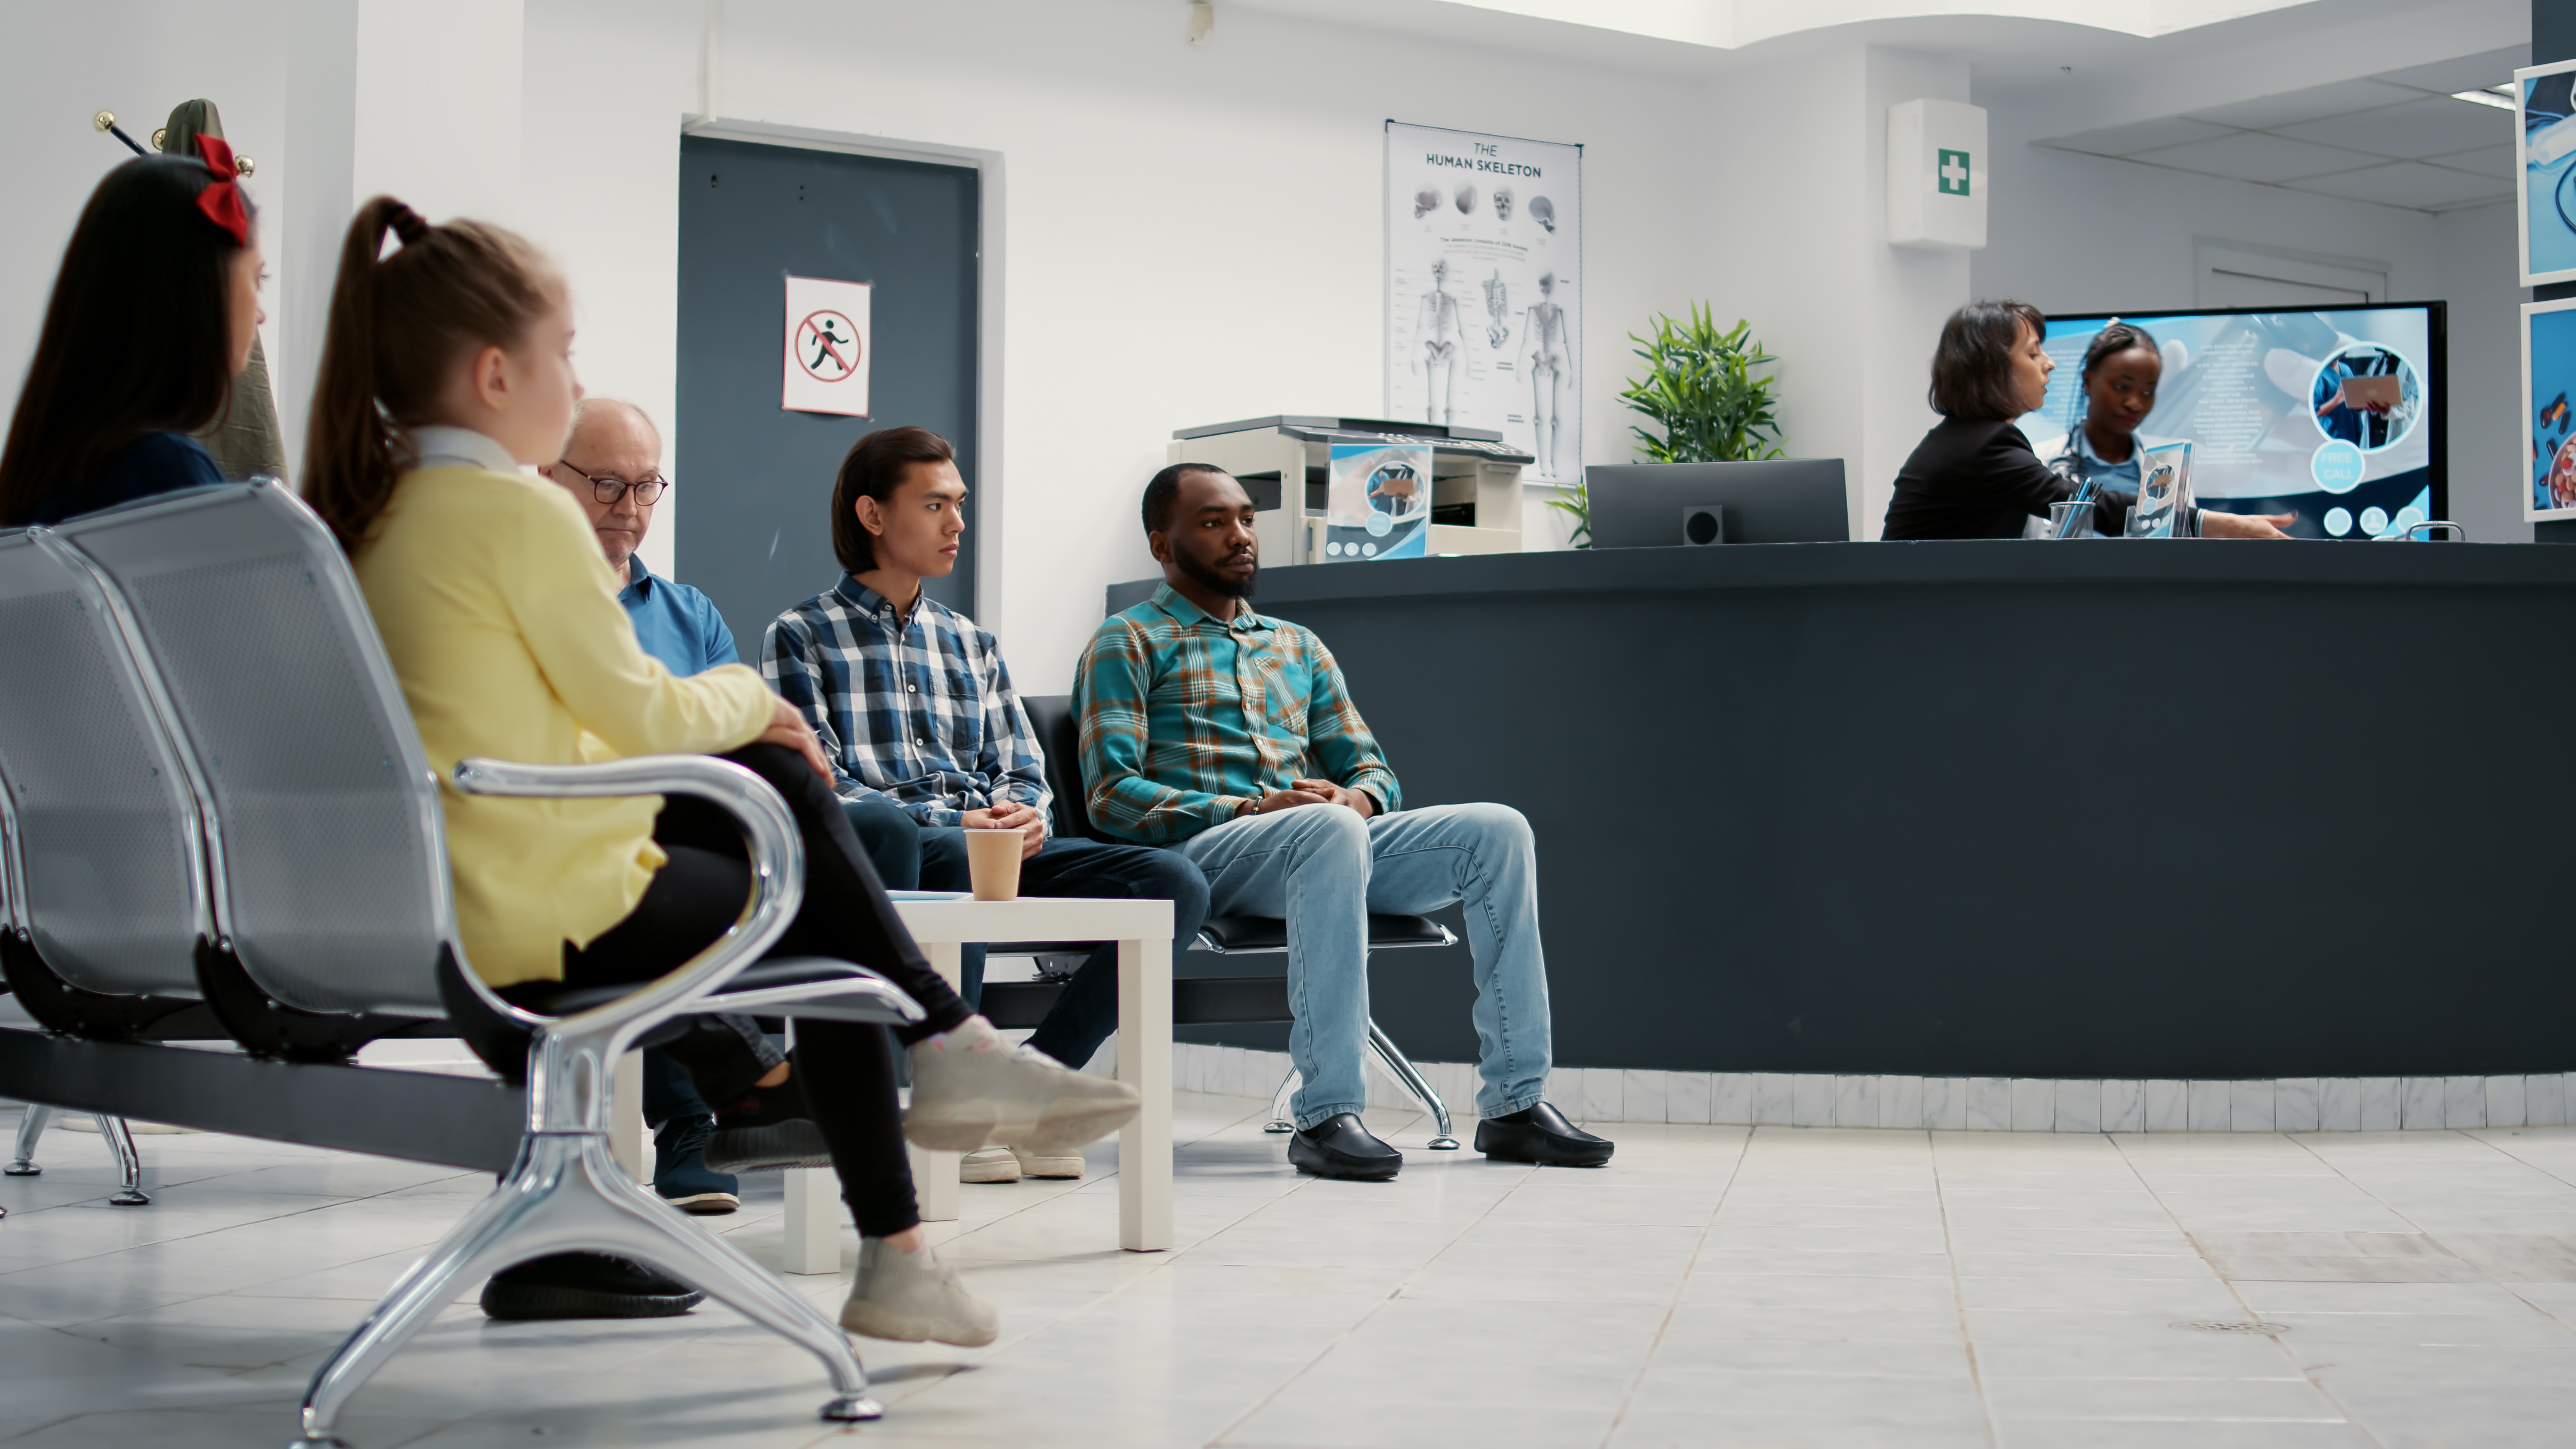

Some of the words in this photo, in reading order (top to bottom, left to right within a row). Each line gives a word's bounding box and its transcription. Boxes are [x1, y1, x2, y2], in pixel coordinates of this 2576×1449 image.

[1474, 143, 1498, 156] THE
[1426, 153, 1472, 169] HUMAN
[1477, 159, 1541, 178] SKELETON
[2321, 452, 2353, 463] FREE
[2324, 468, 2355, 480] CALL
